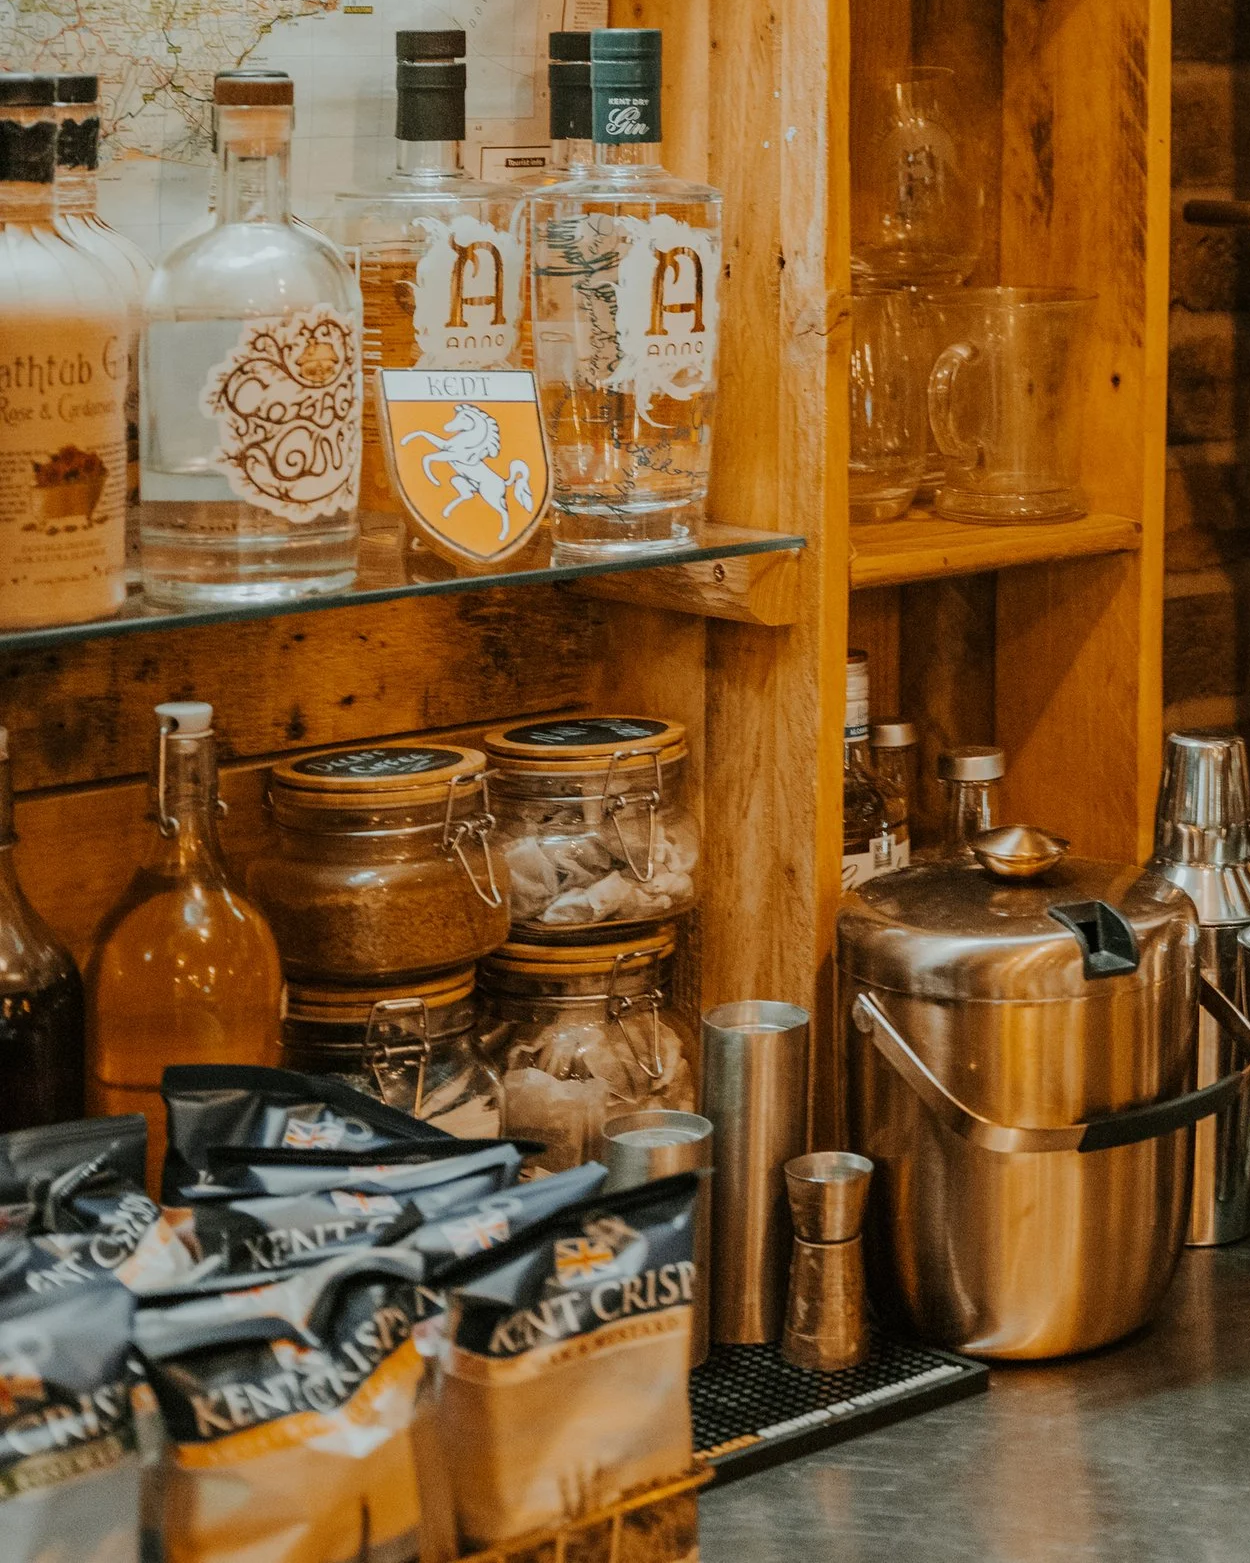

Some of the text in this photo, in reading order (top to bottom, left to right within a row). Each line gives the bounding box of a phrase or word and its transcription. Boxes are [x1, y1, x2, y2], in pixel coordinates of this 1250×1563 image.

[608, 97, 631, 105] KENT
[605, 106, 650, 135] Gin
[508, 158, 529, 166] Tourist
[0, 352, 92, 395] athtub
[426, 373, 491, 399] KENT
[26, 1251, 97, 1294] ENT
[591, 1261, 698, 1322] CRISP
